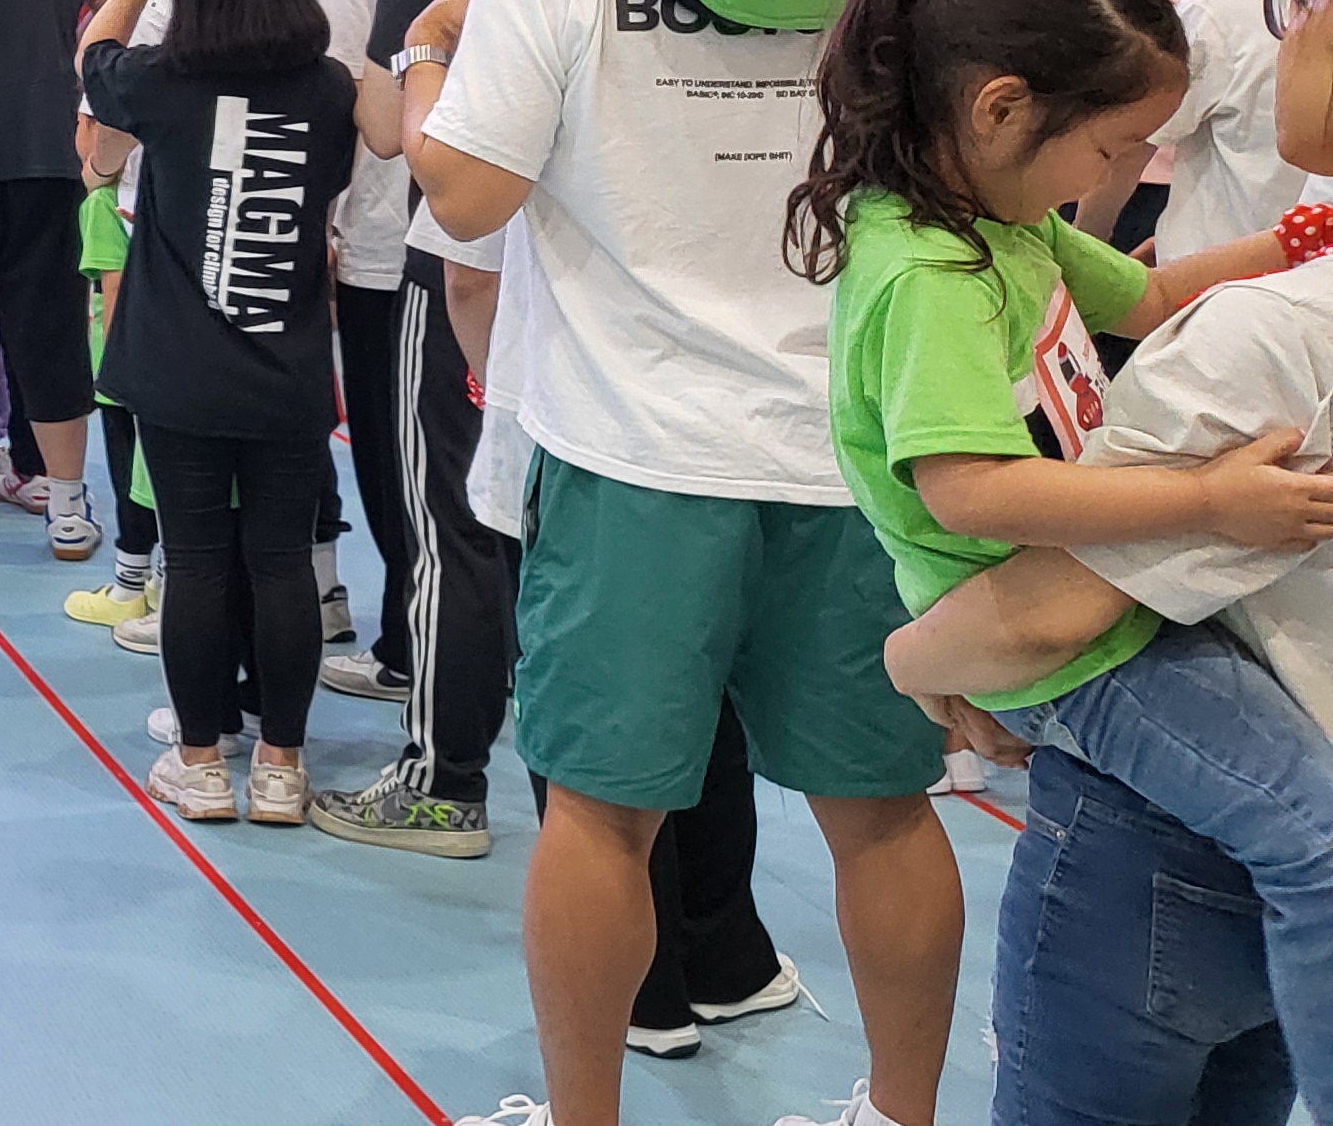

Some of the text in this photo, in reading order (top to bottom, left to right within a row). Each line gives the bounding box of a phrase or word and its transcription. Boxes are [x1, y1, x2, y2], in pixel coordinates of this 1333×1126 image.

[655, 78, 679, 87] EASY
[681, 78, 694, 87] TO
[206, 177, 230, 228] design
[205, 230, 224, 251] for
